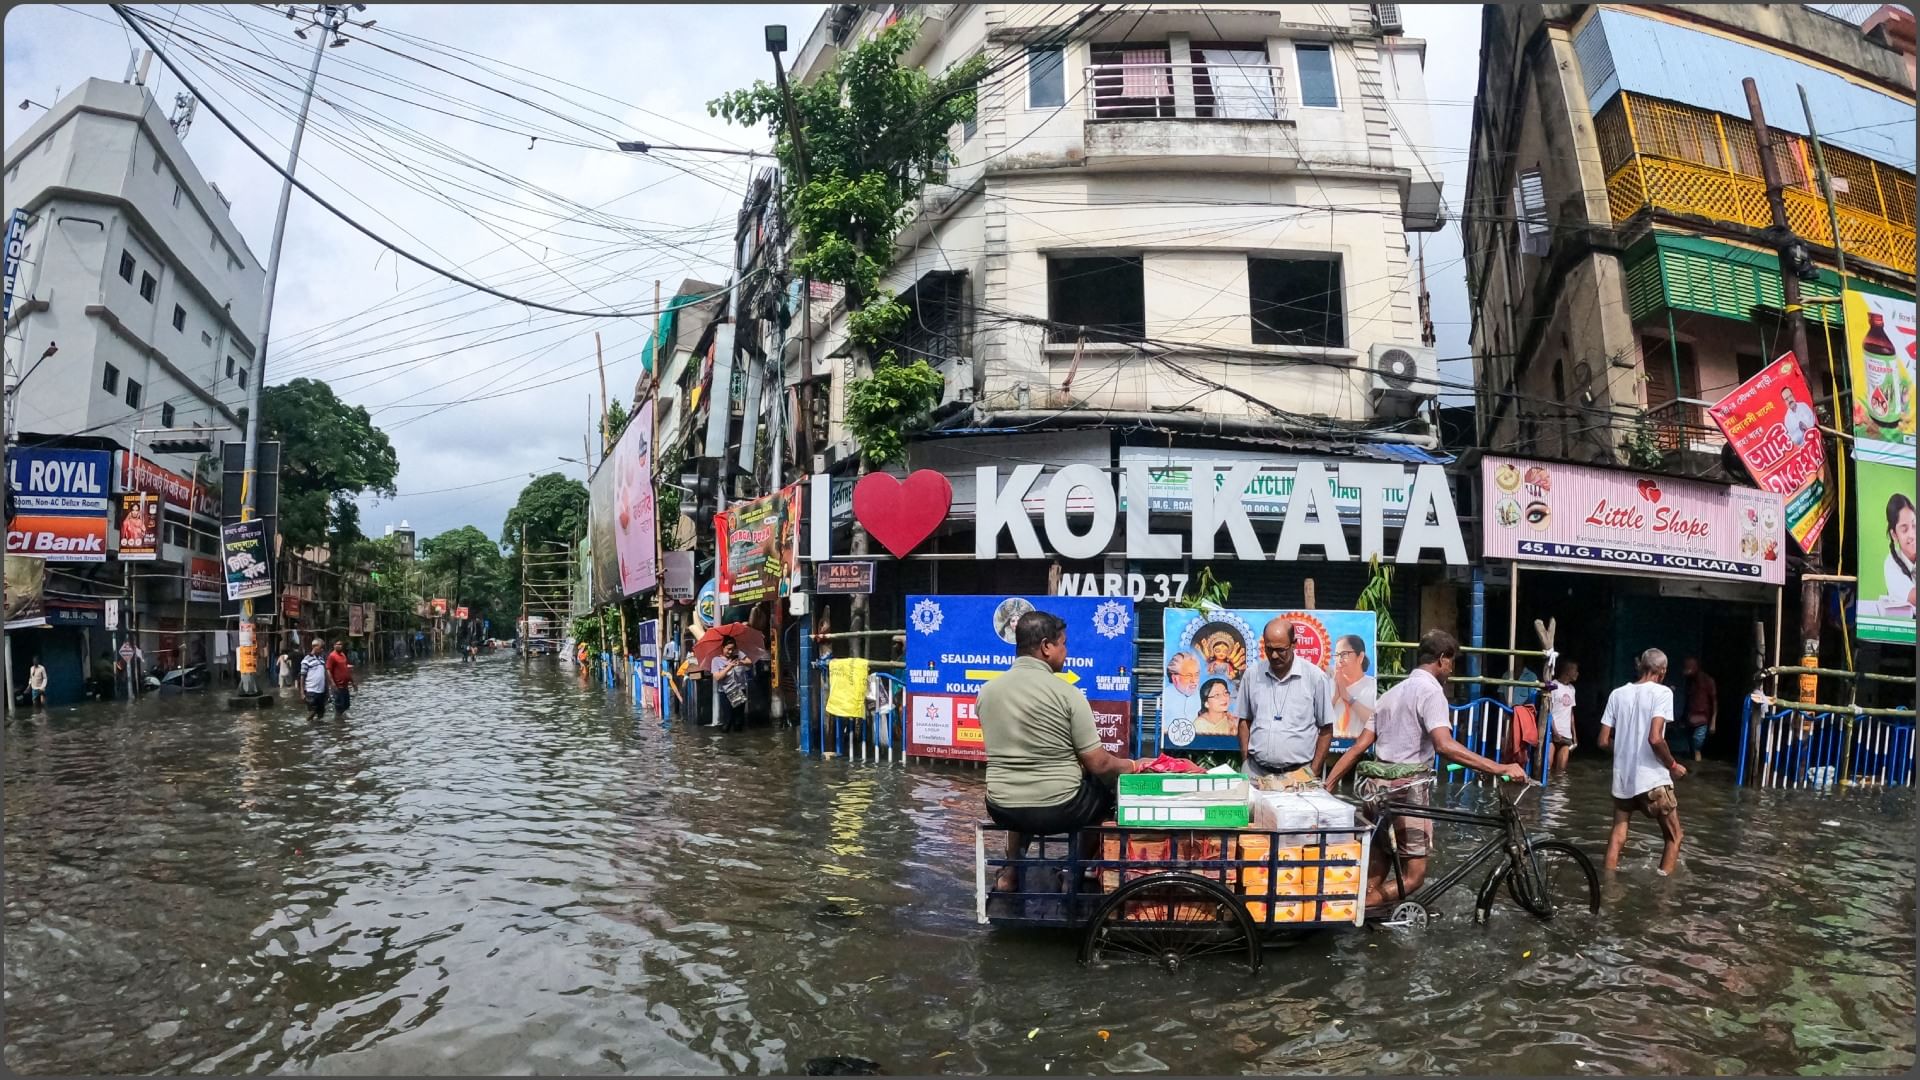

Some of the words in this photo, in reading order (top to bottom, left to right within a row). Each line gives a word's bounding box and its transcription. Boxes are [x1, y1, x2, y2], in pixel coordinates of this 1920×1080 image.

[29, 460, 101, 494] ROYAL
[811, 473, 832, 561] I
[975, 461, 1468, 566] KOLKATA
[1585, 498, 1644, 530] Little
[1652, 507, 1710, 540] Shope
[34, 532, 104, 551] Bank
[730, 529, 752, 545] DURGA
[752, 526, 771, 543] PUJA
[1521, 542, 1548, 555] 45,
[1554, 546, 1595, 557] M.G.
[1601, 551, 1657, 564] ROAD,
[1663, 555, 1739, 572] KOLKATA
[1751, 565, 1760, 574] 9
[831, 565, 859, 576] KMC
[1057, 573, 1146, 603] WARD
[1153, 573, 1189, 604] 37
[941, 654, 990, 664] SEALDAH
[946, 683, 983, 693] KOLKA
[1096, 675, 1111, 683] SAFE
[1112, 676, 1131, 684] DRIVE
[1097, 683, 1114, 691] SAVE
[1115, 683, 1129, 691] LIFE
